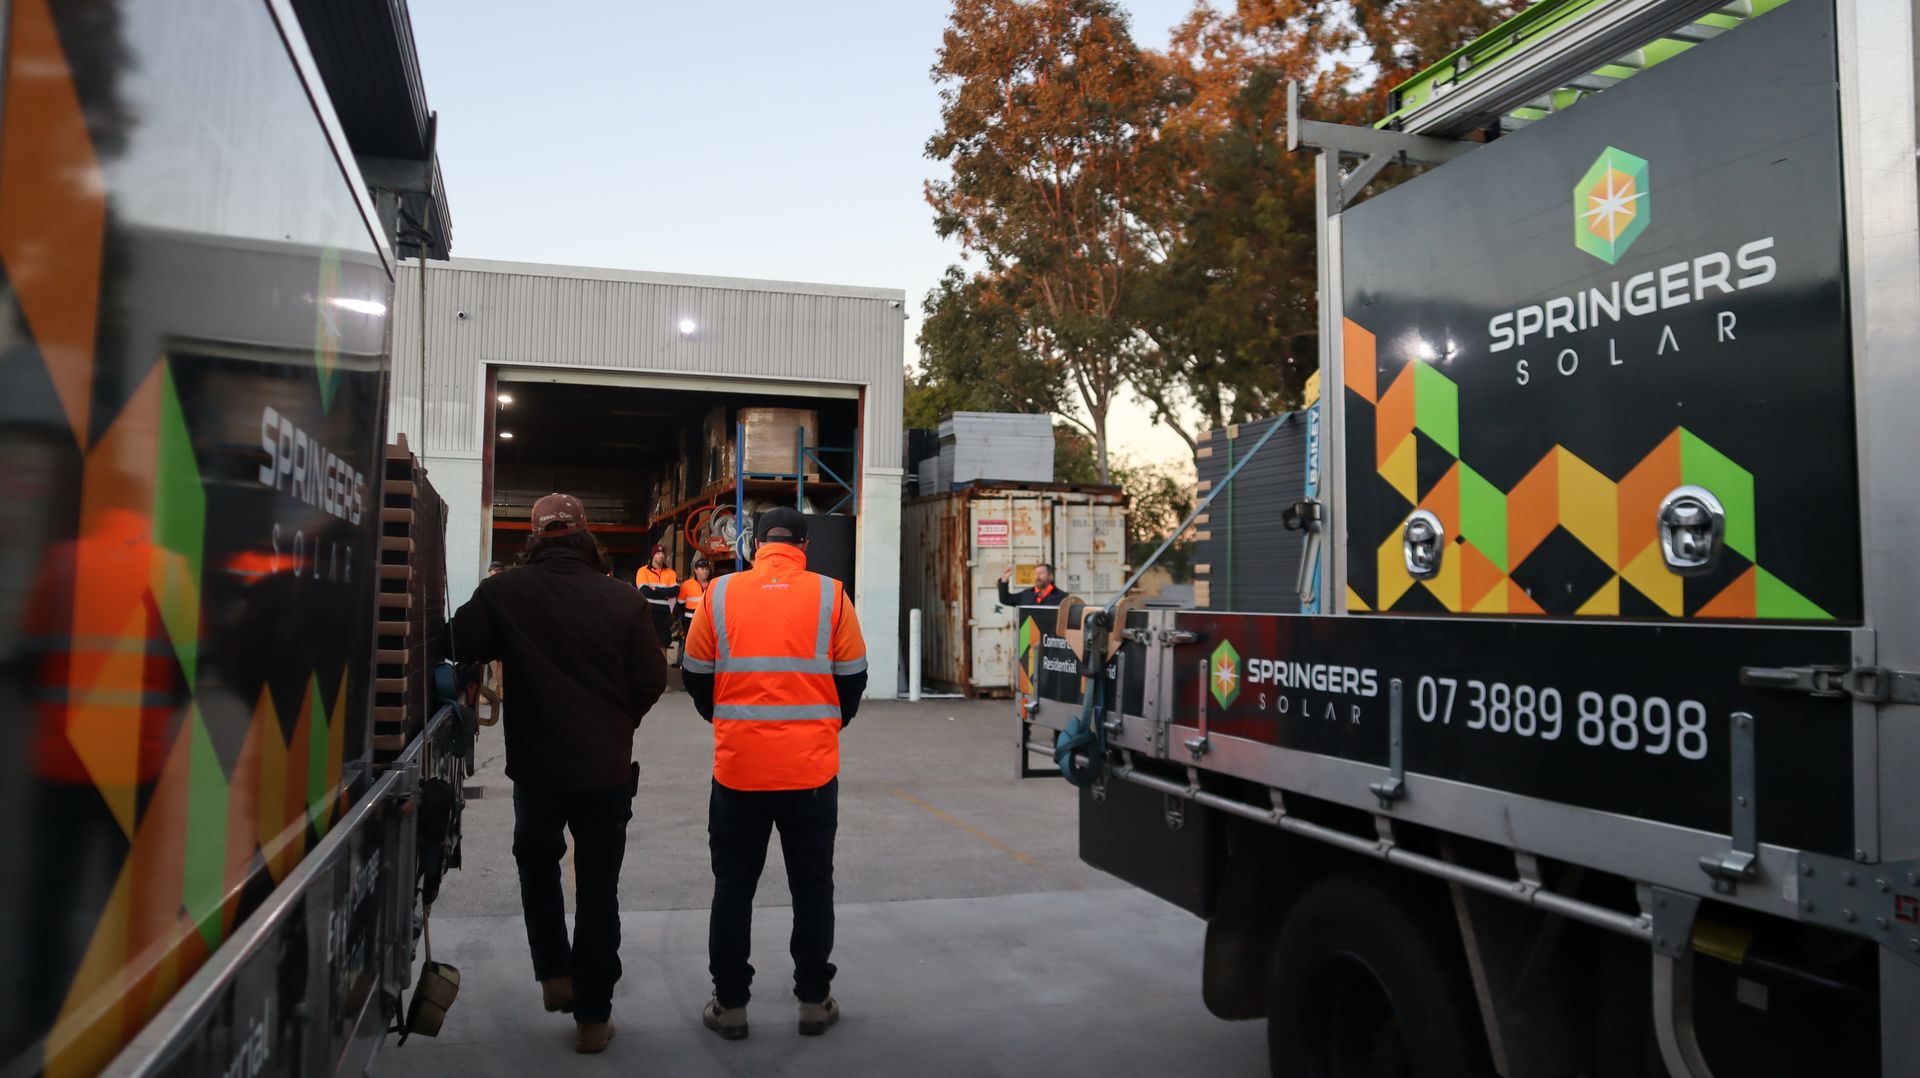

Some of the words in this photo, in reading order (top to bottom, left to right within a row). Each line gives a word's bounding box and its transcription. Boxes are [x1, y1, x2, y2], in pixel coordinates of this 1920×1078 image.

[1488, 236, 1777, 353] SPRINGERS
[1516, 310, 1738, 386] SOLAR
[259, 405, 364, 526] SPRINGERS
[1309, 410, 1319, 484] BAILEY
[271, 522, 352, 583] SOLAR
[1042, 633, 1072, 650] Commerc
[1042, 656, 1077, 674] Residential
[1247, 658, 1378, 697] SPRINGERS
[1257, 693, 1361, 725] SOLAR
[1416, 675, 1458, 725] 07
[1466, 679, 1563, 741] 3889
[1576, 690, 1709, 761] 8898
